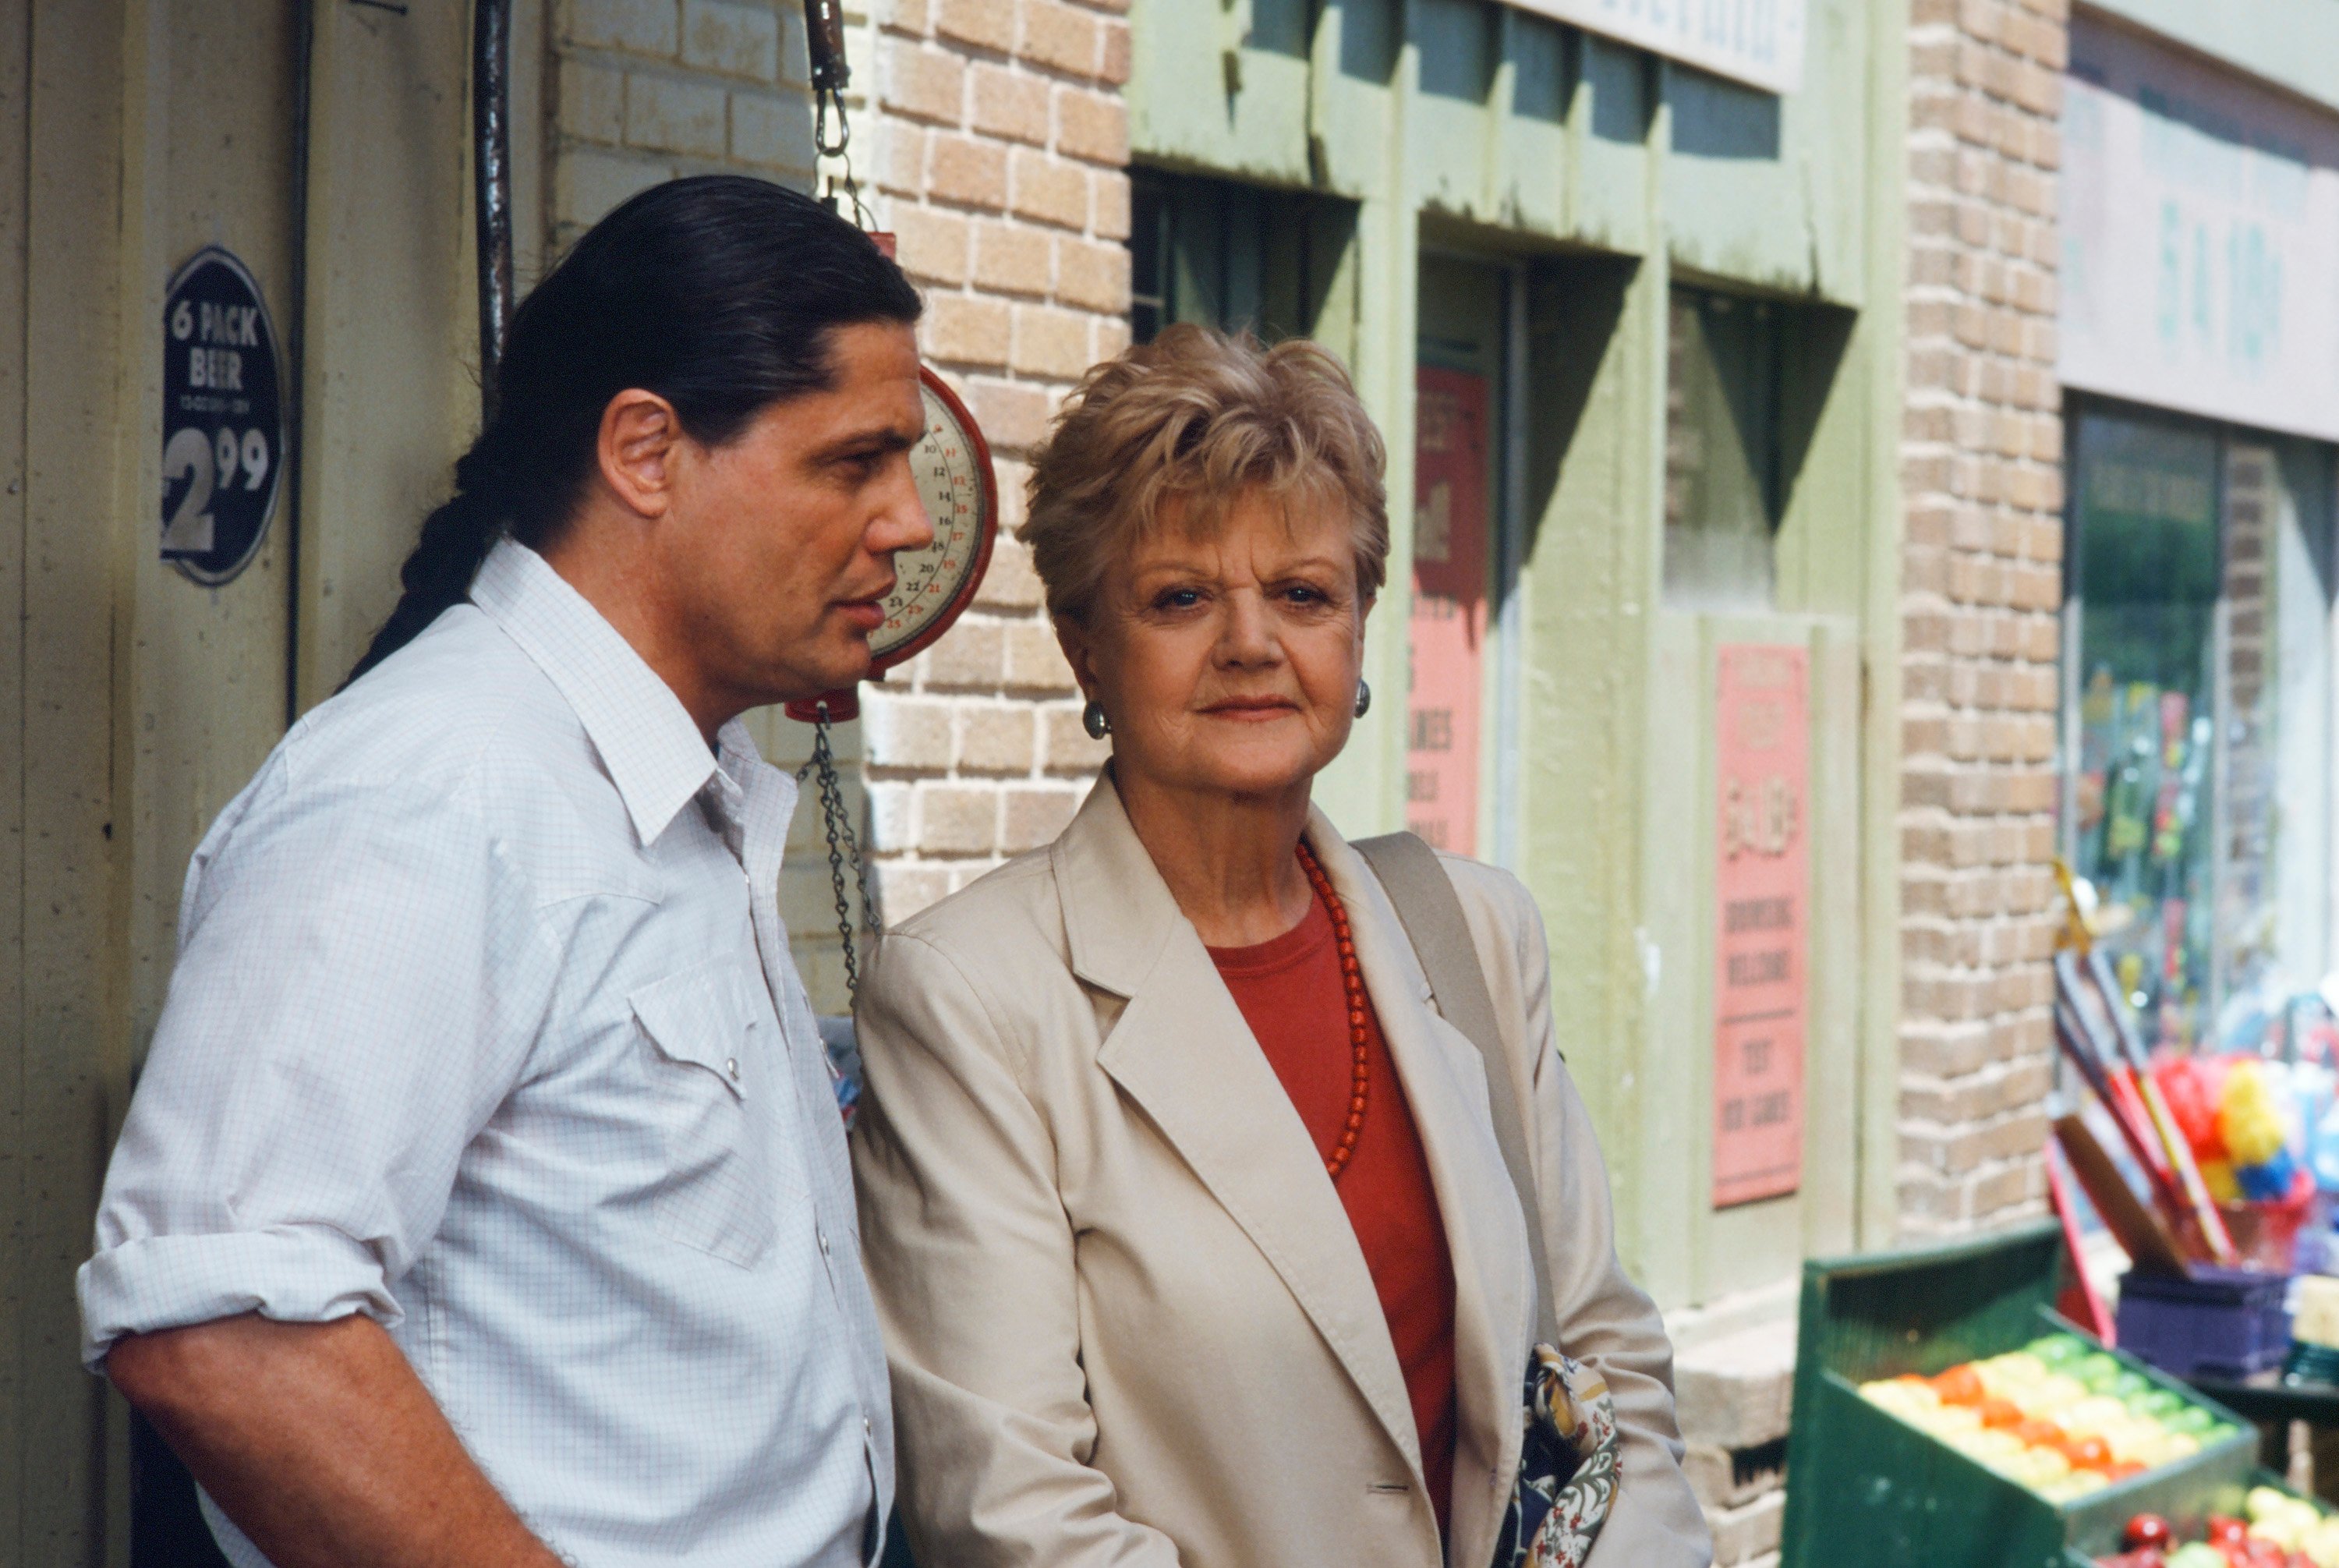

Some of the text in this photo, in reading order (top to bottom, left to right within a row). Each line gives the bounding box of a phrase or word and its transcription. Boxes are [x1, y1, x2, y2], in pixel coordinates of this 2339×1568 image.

[172, 299, 260, 347] 6 PACK
[189, 346, 244, 391] BEER
[924, 444, 936, 455] 10
[945, 448, 957, 458] 11
[934, 466, 946, 477] 12
[939, 491, 951, 502] 14
[956, 504, 968, 514] 15
[939, 516, 952, 526] 16
[919, 563, 935, 574] 20
[905, 580, 920, 592] 22
[929, 583, 941, 593] 21
